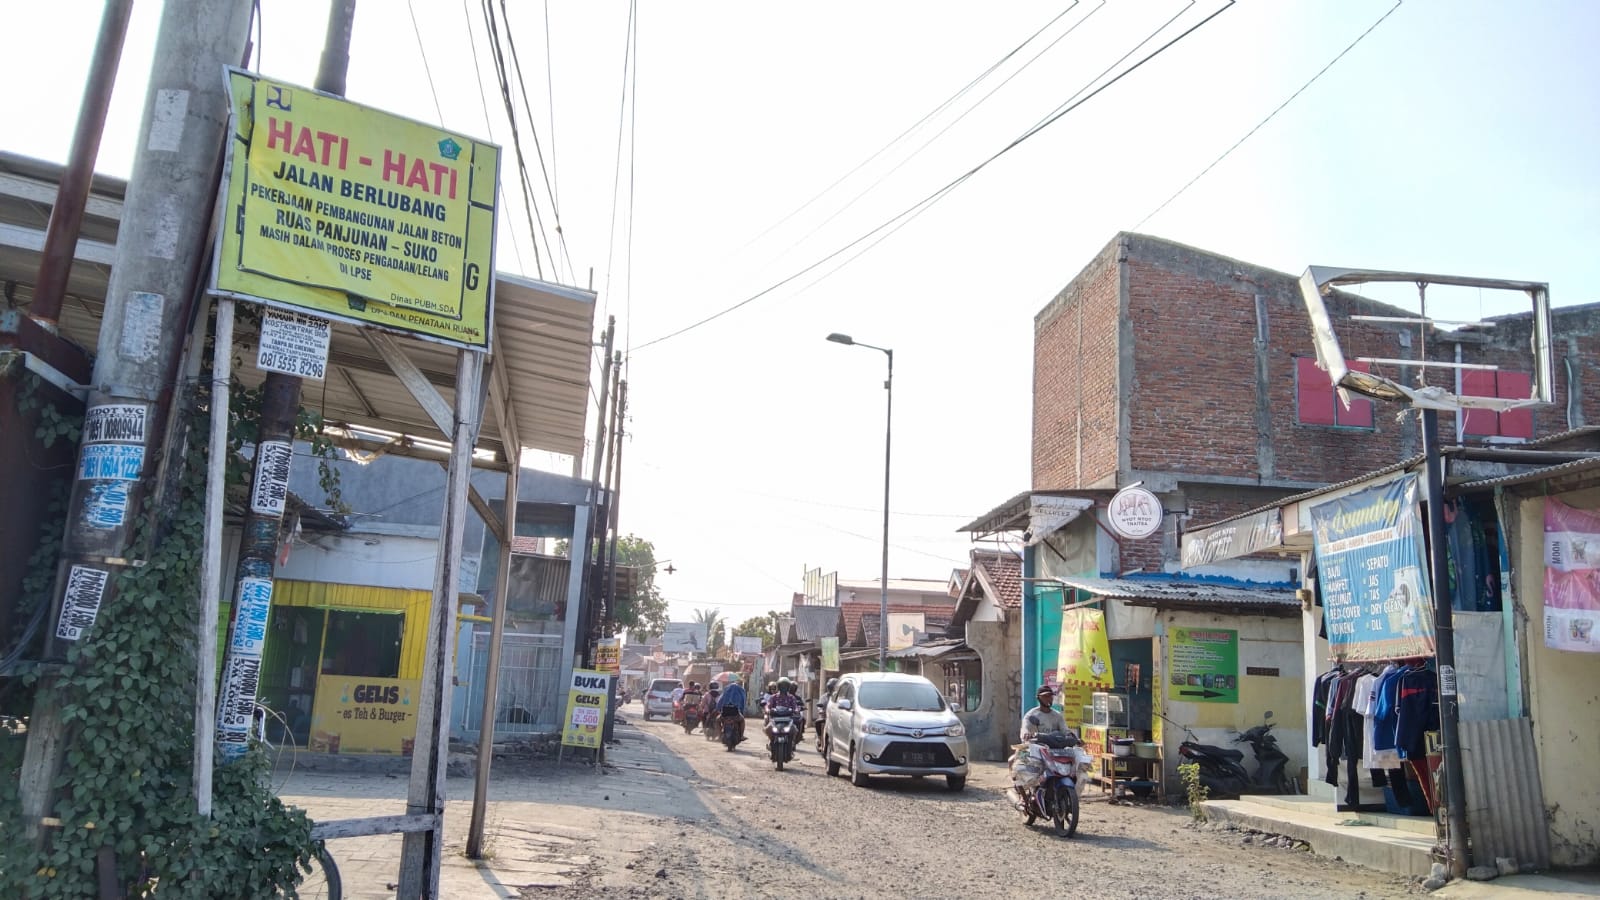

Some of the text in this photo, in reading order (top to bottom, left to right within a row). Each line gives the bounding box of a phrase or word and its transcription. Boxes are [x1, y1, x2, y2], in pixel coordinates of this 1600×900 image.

[266, 117, 348, 170] HATI
[382, 149, 458, 200] HATI
[274, 162, 446, 222] JALAN BERLUBANG
[251, 183, 462, 249] PEKERJAAN PEMBANGUNAN JALAN BETON
[276, 208, 312, 232] RUAS
[316, 220, 388, 251] PANJUNAN
[404, 241, 438, 262] SUKO
[260, 225, 449, 281] MASIH DALAM PROSES PENGADAAN/LELANG
[340, 262, 372, 280] DI LPSE
[390, 292, 412, 305] Dinas
[308, 320, 328, 332] 2010
[408, 314, 450, 330] PENATAAN
[452, 325, 480, 336] RUANG
[260, 352, 276, 368] 081
[278, 355, 297, 373] 5555
[300, 360, 324, 378] 8298
[104, 415, 143, 440] 00809944
[121, 446, 143, 454] WC
[257, 466, 270, 507] SEDOT
[264, 444, 272, 463] WC
[270, 482, 286, 500] 0851
[1333, 496, 1400, 534] Laundry
[1552, 541, 1562, 564] MOON
[1327, 566, 1341, 579] BAJU
[1366, 555, 1388, 571] SEPATU
[69, 568, 80, 588] WC
[1369, 574, 1379, 588] JAS
[70, 569, 106, 628] 0851 00809944
[1328, 592, 1352, 606] SELIMUT
[1369, 588, 1380, 600] TAS
[232, 582, 251, 648] SEDOT WC
[247, 584, 270, 640] 0851 0604 1222
[1370, 600, 1404, 616] DRY CLEAN
[1372, 618, 1382, 631] DLL
[224, 658, 241, 724] SEDOT WC
[236, 658, 260, 716] 0851 00809944
[574, 676, 606, 689] BUKA
[354, 684, 400, 704] GELIS
[576, 694, 600, 705] GELIS
[343, 709, 352, 720] es
[354, 707, 368, 720] Teh
[370, 708, 376, 720] &
[378, 708, 406, 724] Burger
[574, 714, 598, 724] 2.500
